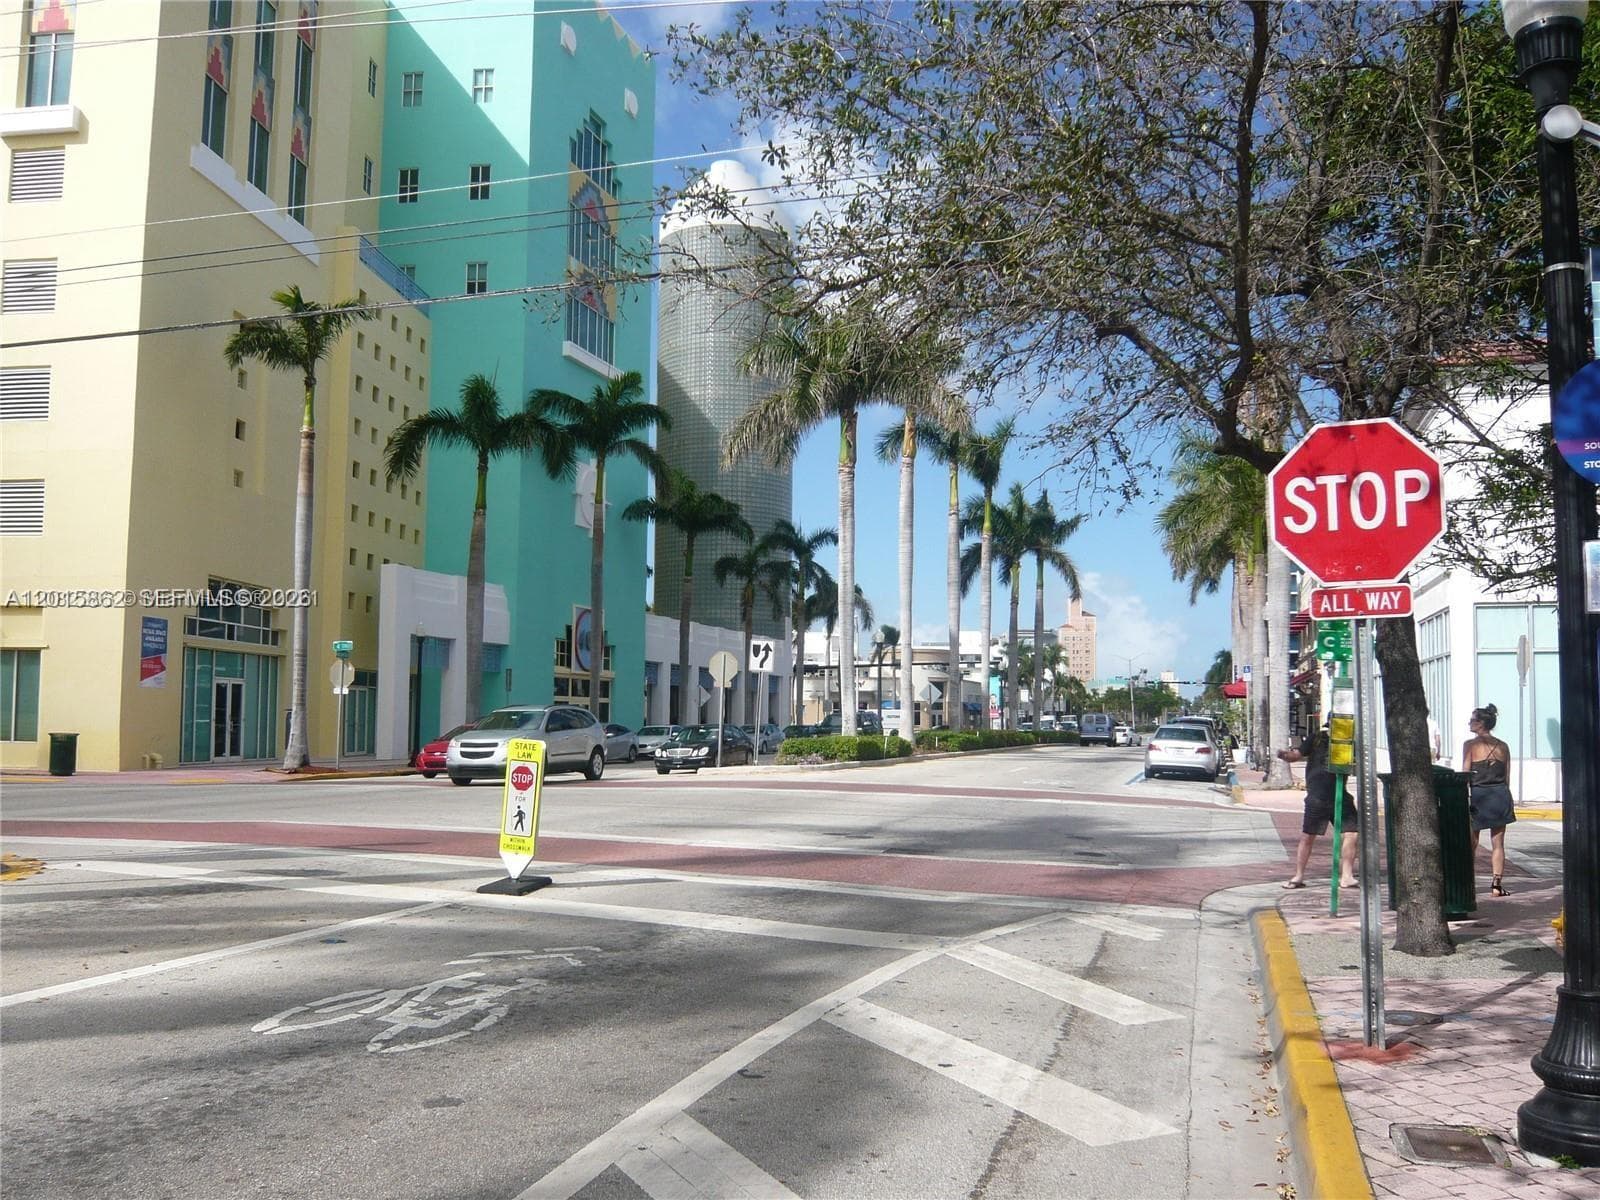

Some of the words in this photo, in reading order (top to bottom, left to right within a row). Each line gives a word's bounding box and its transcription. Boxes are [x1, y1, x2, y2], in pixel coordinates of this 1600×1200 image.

[1283, 469, 1430, 534] STOP
[1320, 593, 1355, 612] ALL
[1365, 591, 1403, 611] WAY
[514, 742, 536, 751] STATE
[512, 773, 532, 784] STOP
